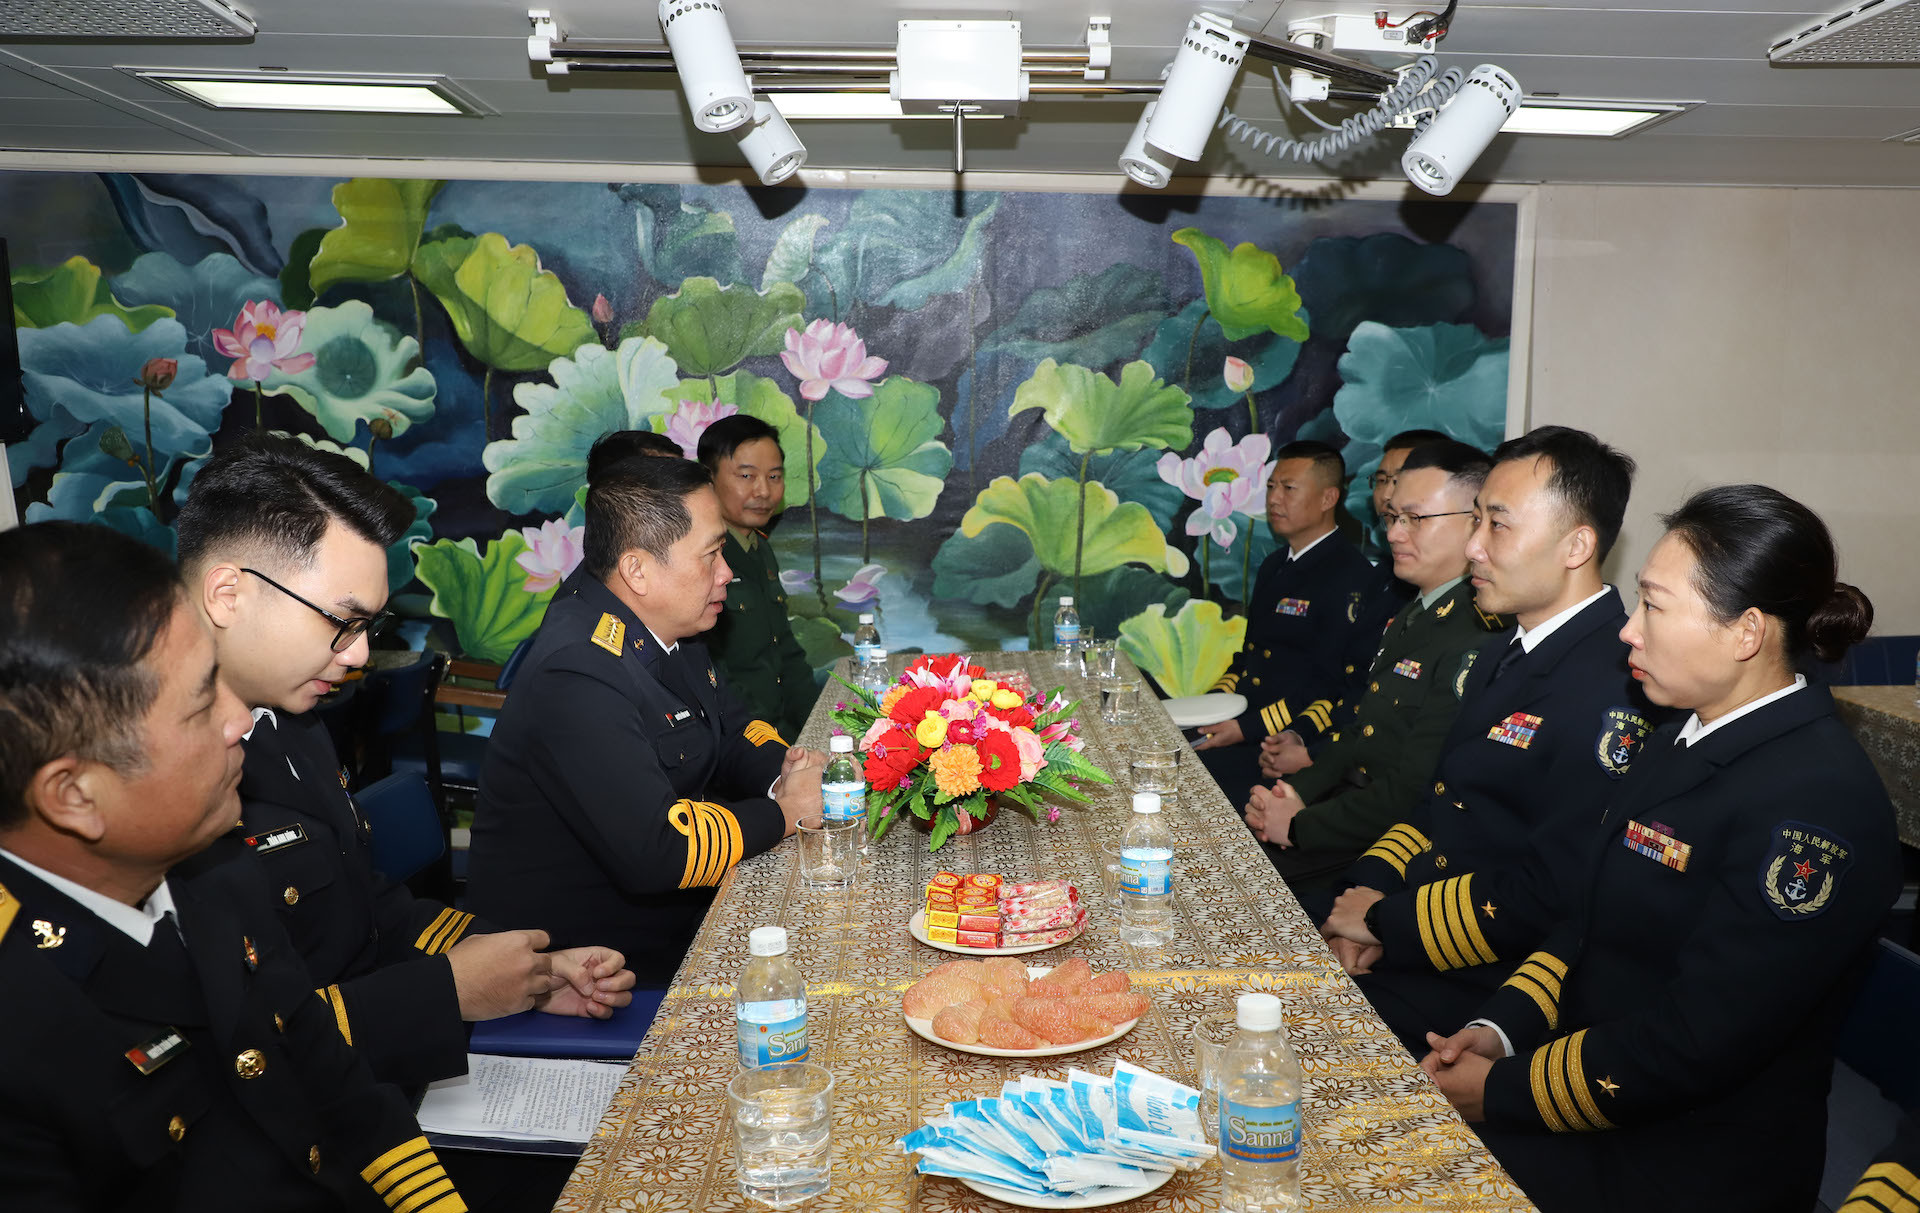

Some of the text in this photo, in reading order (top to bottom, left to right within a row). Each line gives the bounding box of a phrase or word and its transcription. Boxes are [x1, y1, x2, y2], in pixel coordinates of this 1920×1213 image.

[1782, 828, 1849, 860] 中国人民解放军
[1120, 871, 1140, 886] nna
[767, 1030, 808, 1060] San
[1229, 1115, 1294, 1148] Sanna
